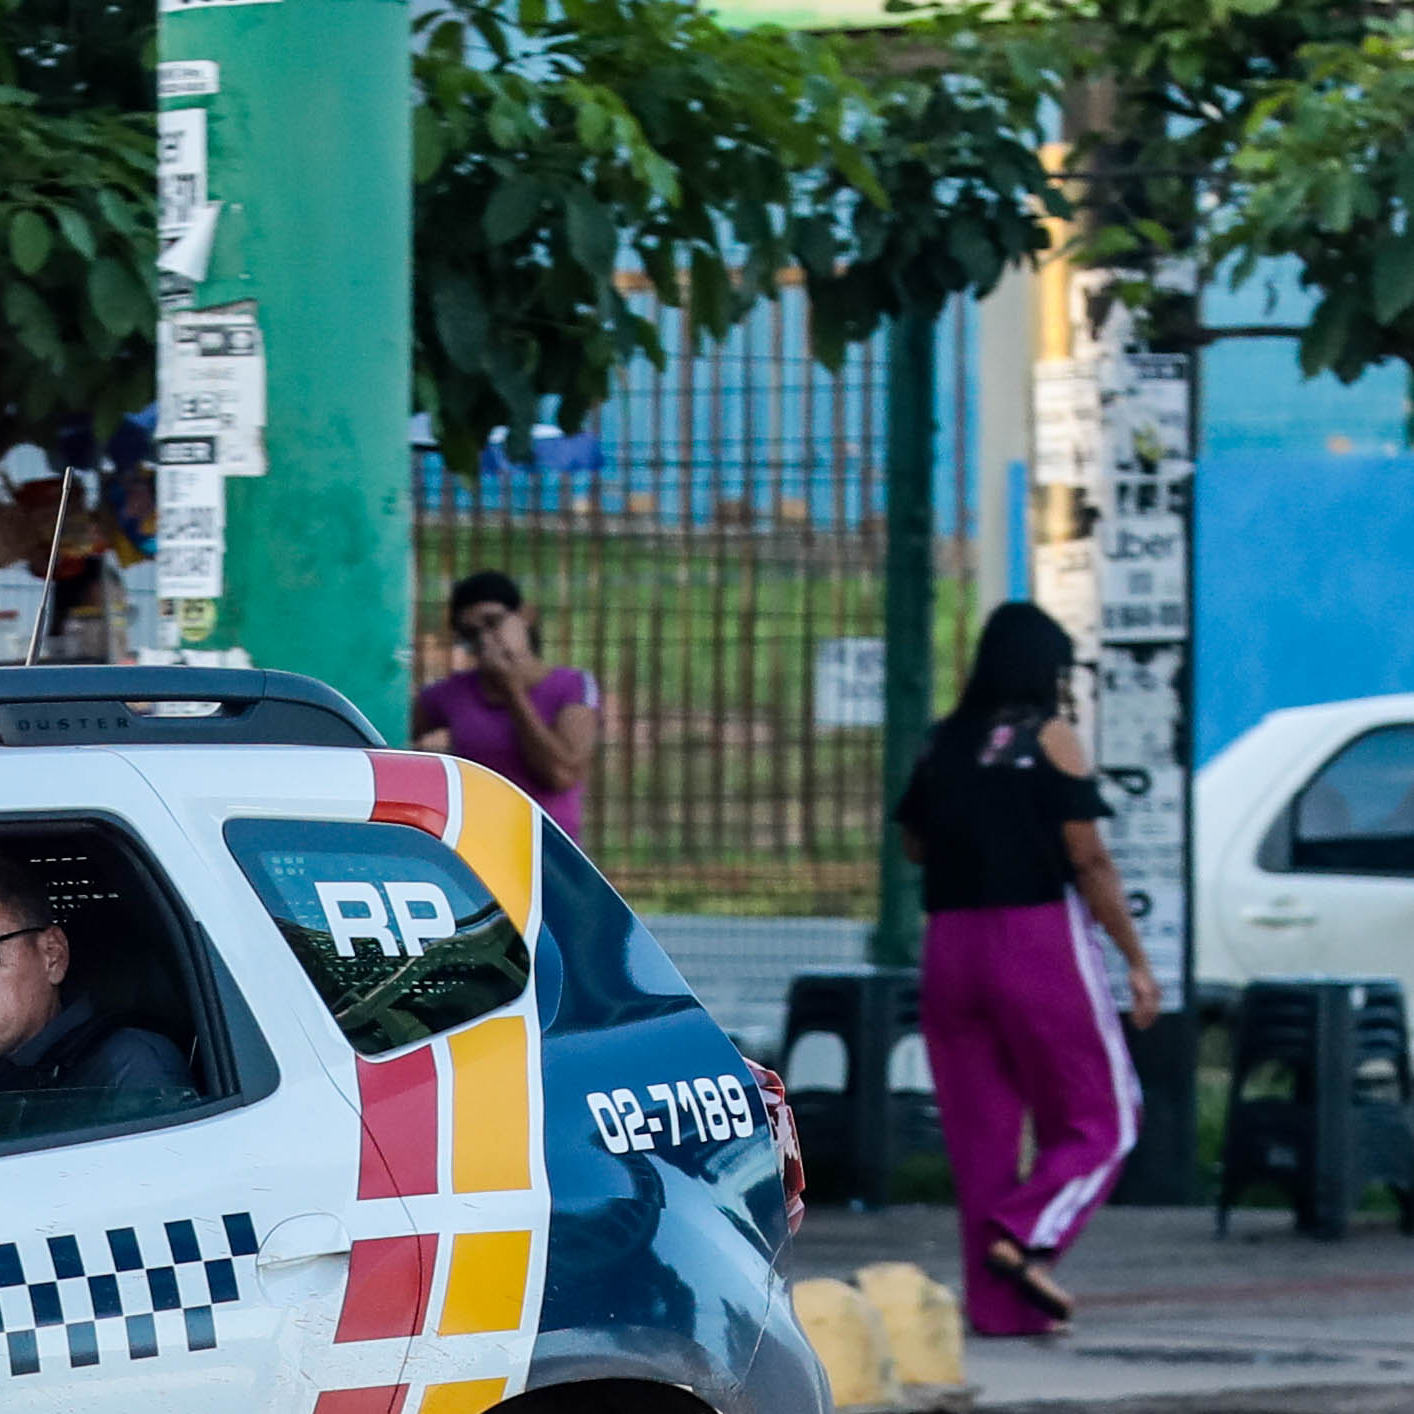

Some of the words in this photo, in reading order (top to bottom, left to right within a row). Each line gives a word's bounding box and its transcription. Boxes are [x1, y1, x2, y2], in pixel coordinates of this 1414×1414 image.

[15, 717, 131, 732] DUSTER
[314, 881, 456, 957] RP
[586, 1074, 754, 1154] 02-7189
